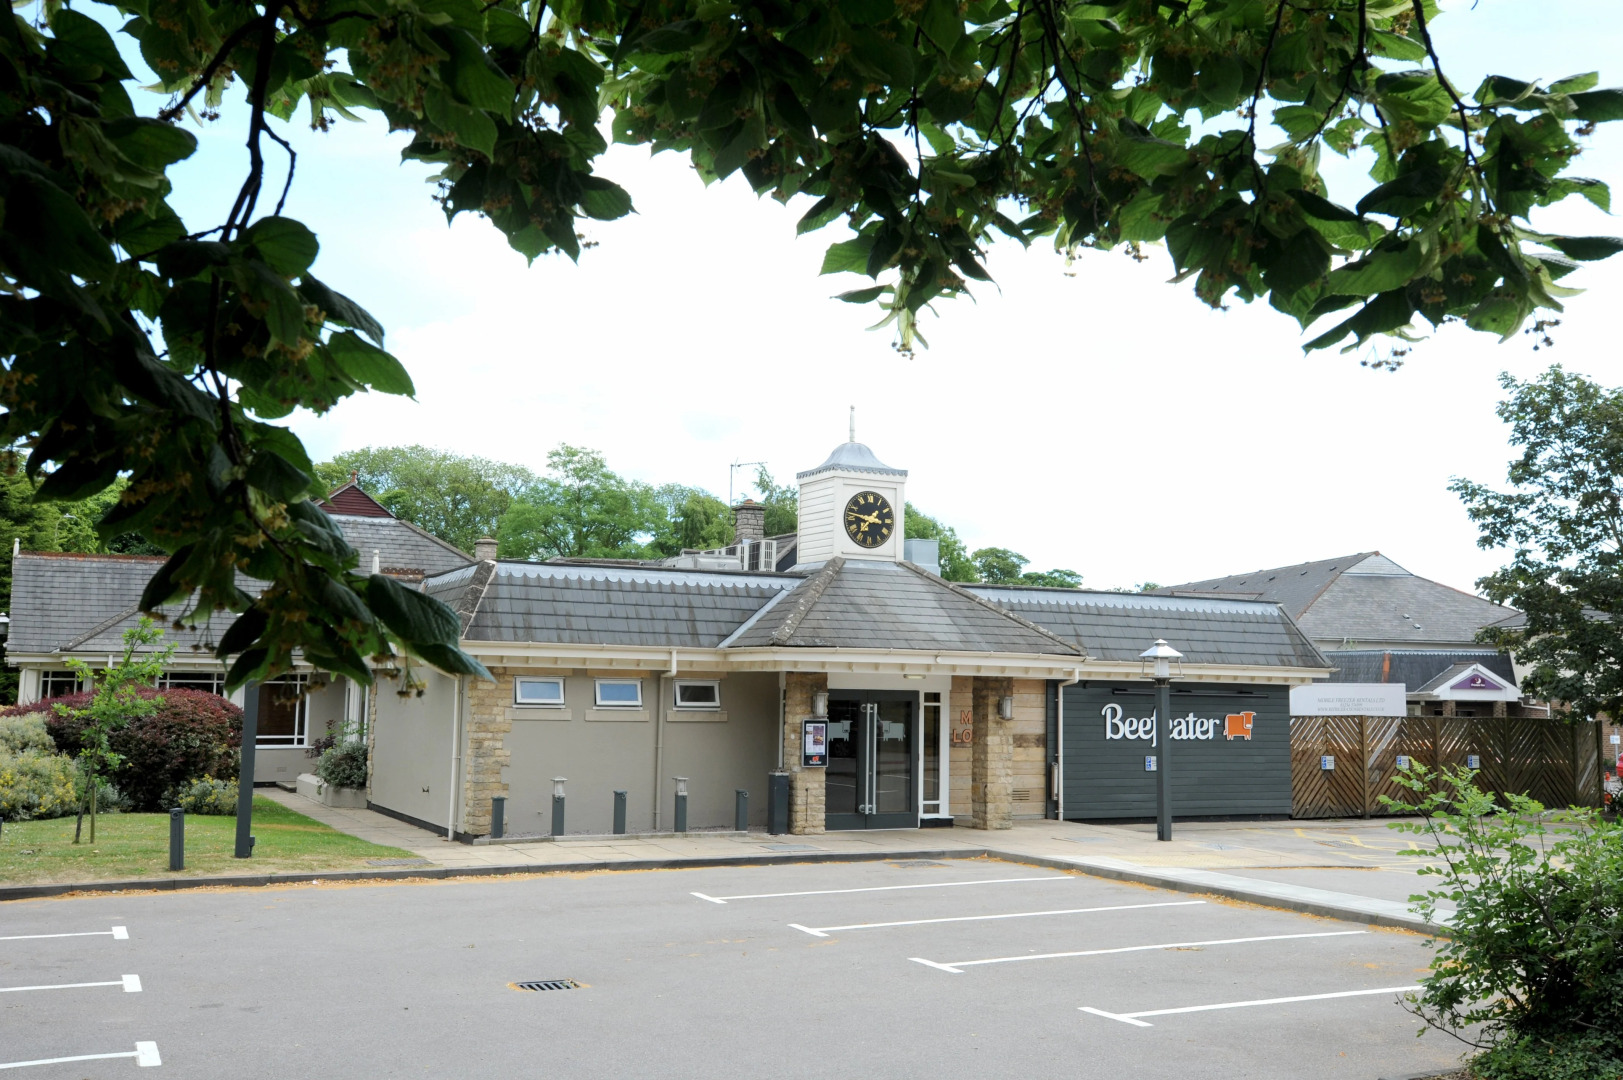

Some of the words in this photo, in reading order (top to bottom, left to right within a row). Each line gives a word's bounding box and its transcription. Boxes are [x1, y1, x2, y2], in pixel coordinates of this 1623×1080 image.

[961, 710, 972, 724] M
[1101, 703, 1220, 747] Beefater
[952, 728, 972, 743] LO
